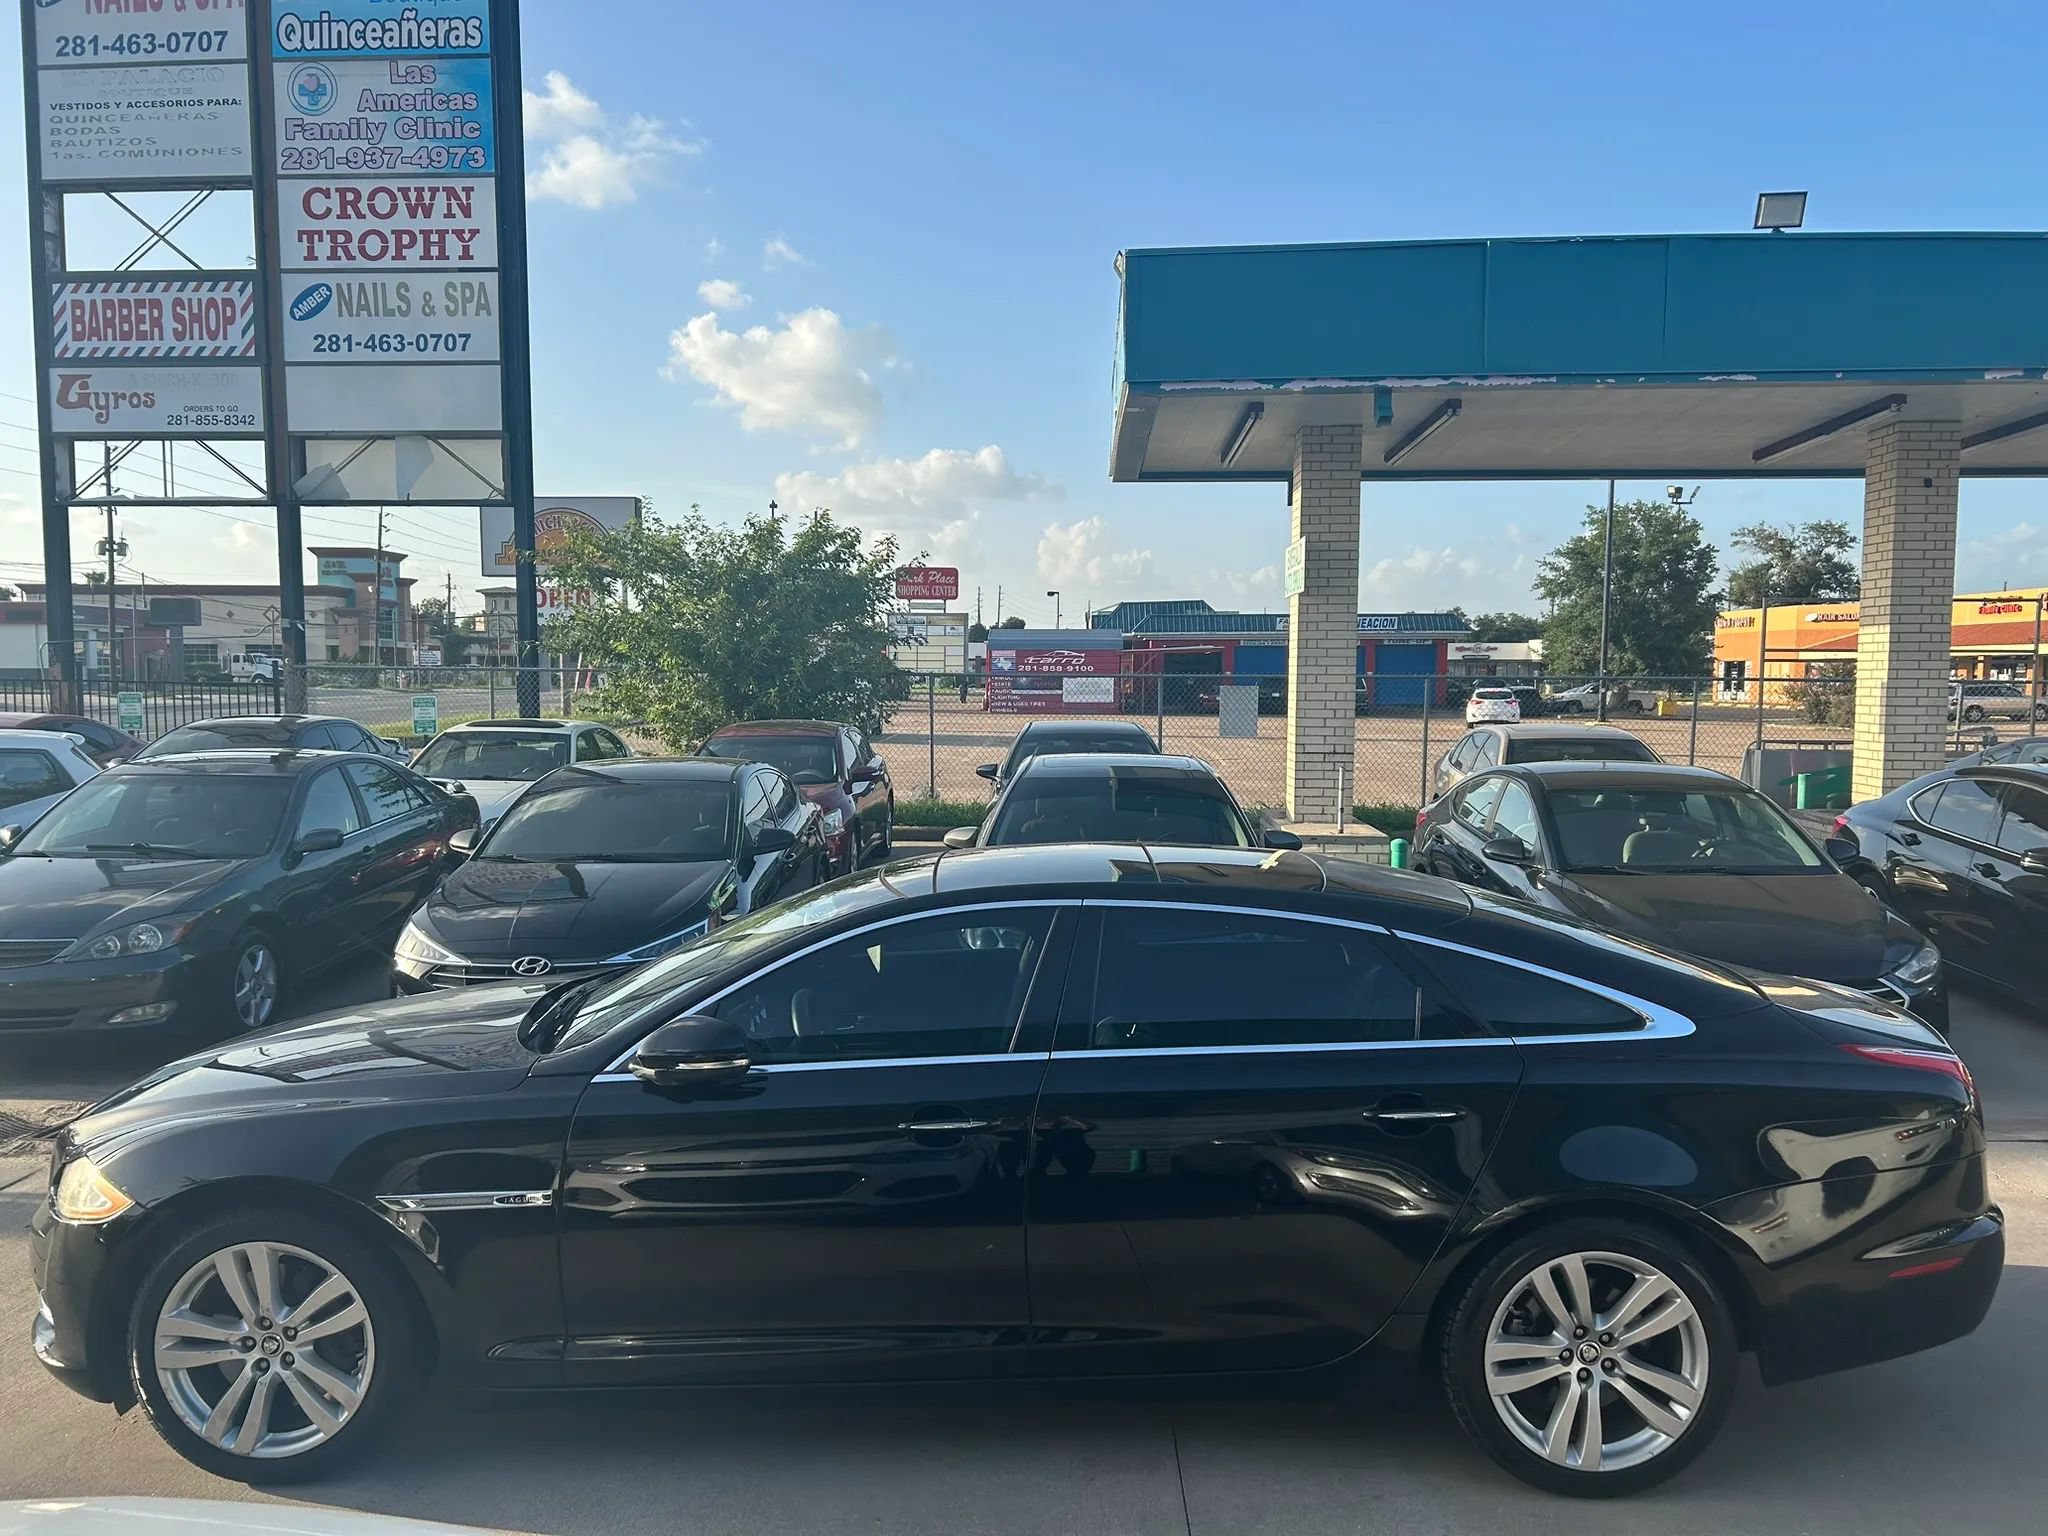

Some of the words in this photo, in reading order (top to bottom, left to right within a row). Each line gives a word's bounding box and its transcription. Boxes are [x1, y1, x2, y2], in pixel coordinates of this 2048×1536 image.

[277, 8, 483, 52] Quinceañeras
[55, 30, 228, 57] 281-463-0707
[389, 60, 436, 84] Las
[50, 102, 110, 111] VESTIDOS
[115, 101, 122, 109] Y
[126, 99, 204, 109] ACCESORIOS
[207, 98, 242, 107] PARA:
[357, 88, 478, 112] Americas
[50, 126, 121, 136] BODAS
[50, 137, 157, 148] BAUTIZOS
[285, 118, 386, 145] Family
[394, 117, 481, 139] Clinic
[98, 147, 243, 158] COMUNIONES
[281, 146, 487, 170] 281-937-4973
[302, 186, 475, 220] CROWN
[297, 228, 480, 262] TROPHY
[292, 285, 332, 321] AMBER
[336, 281, 412, 318] NAILS
[421, 291, 436, 317] &
[444, 281, 492, 318] SPA
[70, 298, 164, 342] BARBER
[171, 297, 237, 342] SHOP
[313, 333, 471, 353] 281-463-0707
[56, 374, 155, 425] Gyros
[167, 414, 255, 426] 281-855-8342
[928, 571, 956, 583] Place
[897, 584, 930, 596] SHOPPING
[932, 584, 957, 597] CENTER
[1817, 613, 1836, 621] HAIR
